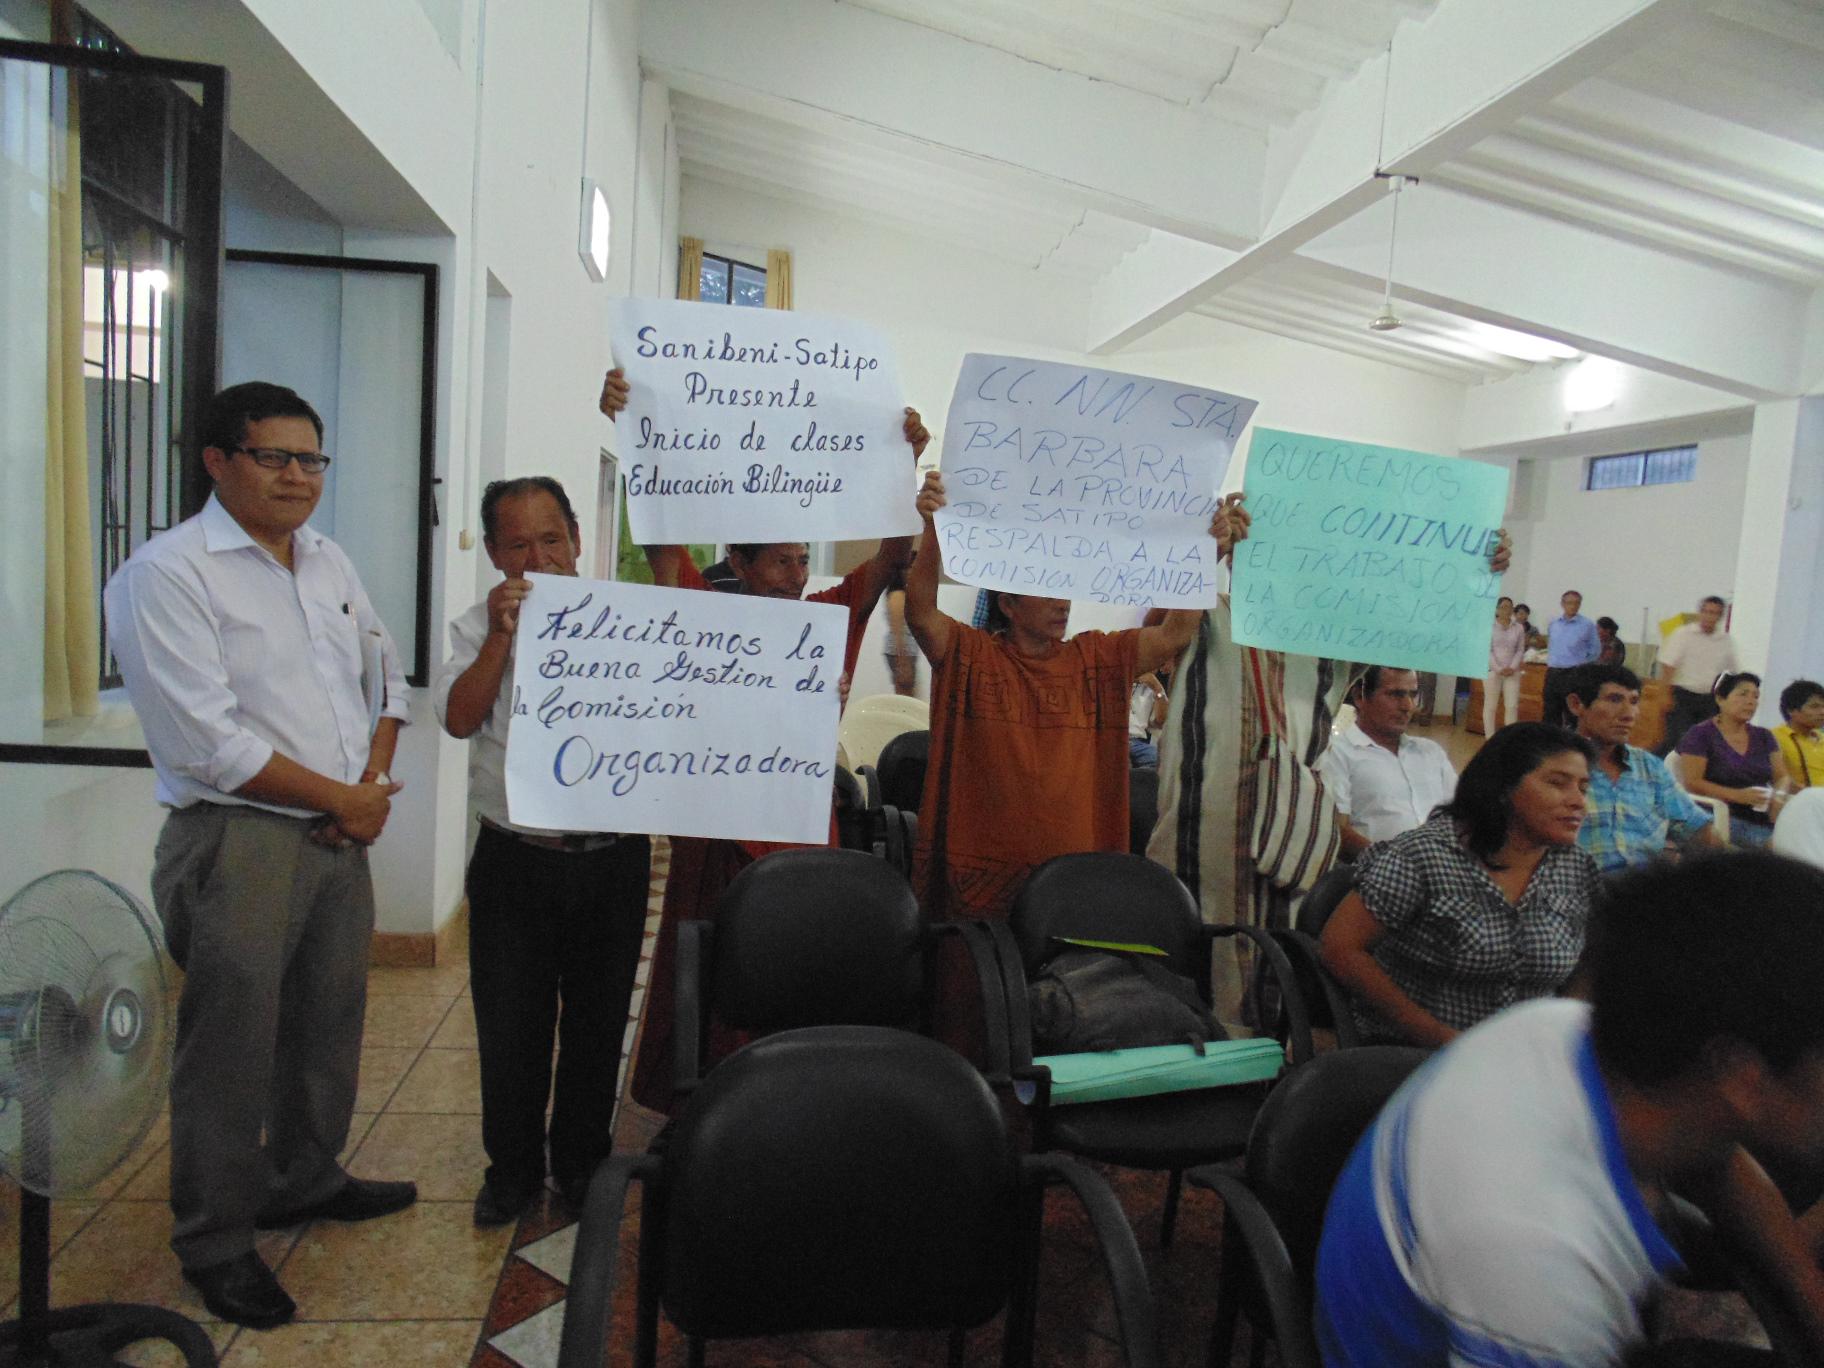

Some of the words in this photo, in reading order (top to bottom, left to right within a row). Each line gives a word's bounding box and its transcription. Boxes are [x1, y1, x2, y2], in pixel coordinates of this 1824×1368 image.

[685, 372, 818, 407] Presente
[635, 416, 721, 450] Inicio
[740, 420, 766, 451] de
[790, 421, 865, 451] clases
[963, 420, 1192, 489] BARBARA
[628, 464, 734, 497] Educación
[742, 463, 843, 508] Bilingüe
[954, 467, 1008, 490] DE
[1029, 475, 1064, 497] LA
[1260, 441, 1460, 500] QUEREMOS
[953, 501, 999, 521] DE
[1022, 503, 1144, 531] SATIPO
[941, 522, 1112, 561] RESPALDA
[1130, 541, 1148, 563] A
[1166, 544, 1202, 564] LA
[950, 555, 1075, 588] COMISION
[1293, 545, 1457, 594] TRABAJO
[537, 593, 762, 656] Felicitamos
[785, 622, 825, 660] la
[1294, 584, 1471, 625] COMISION
[538, 649, 641, 680] Buena
[652, 650, 777, 689] Gestion
[795, 664, 826, 694] de
[537, 685, 697, 729] Comisión
[553, 735, 830, 797] Organizadora
